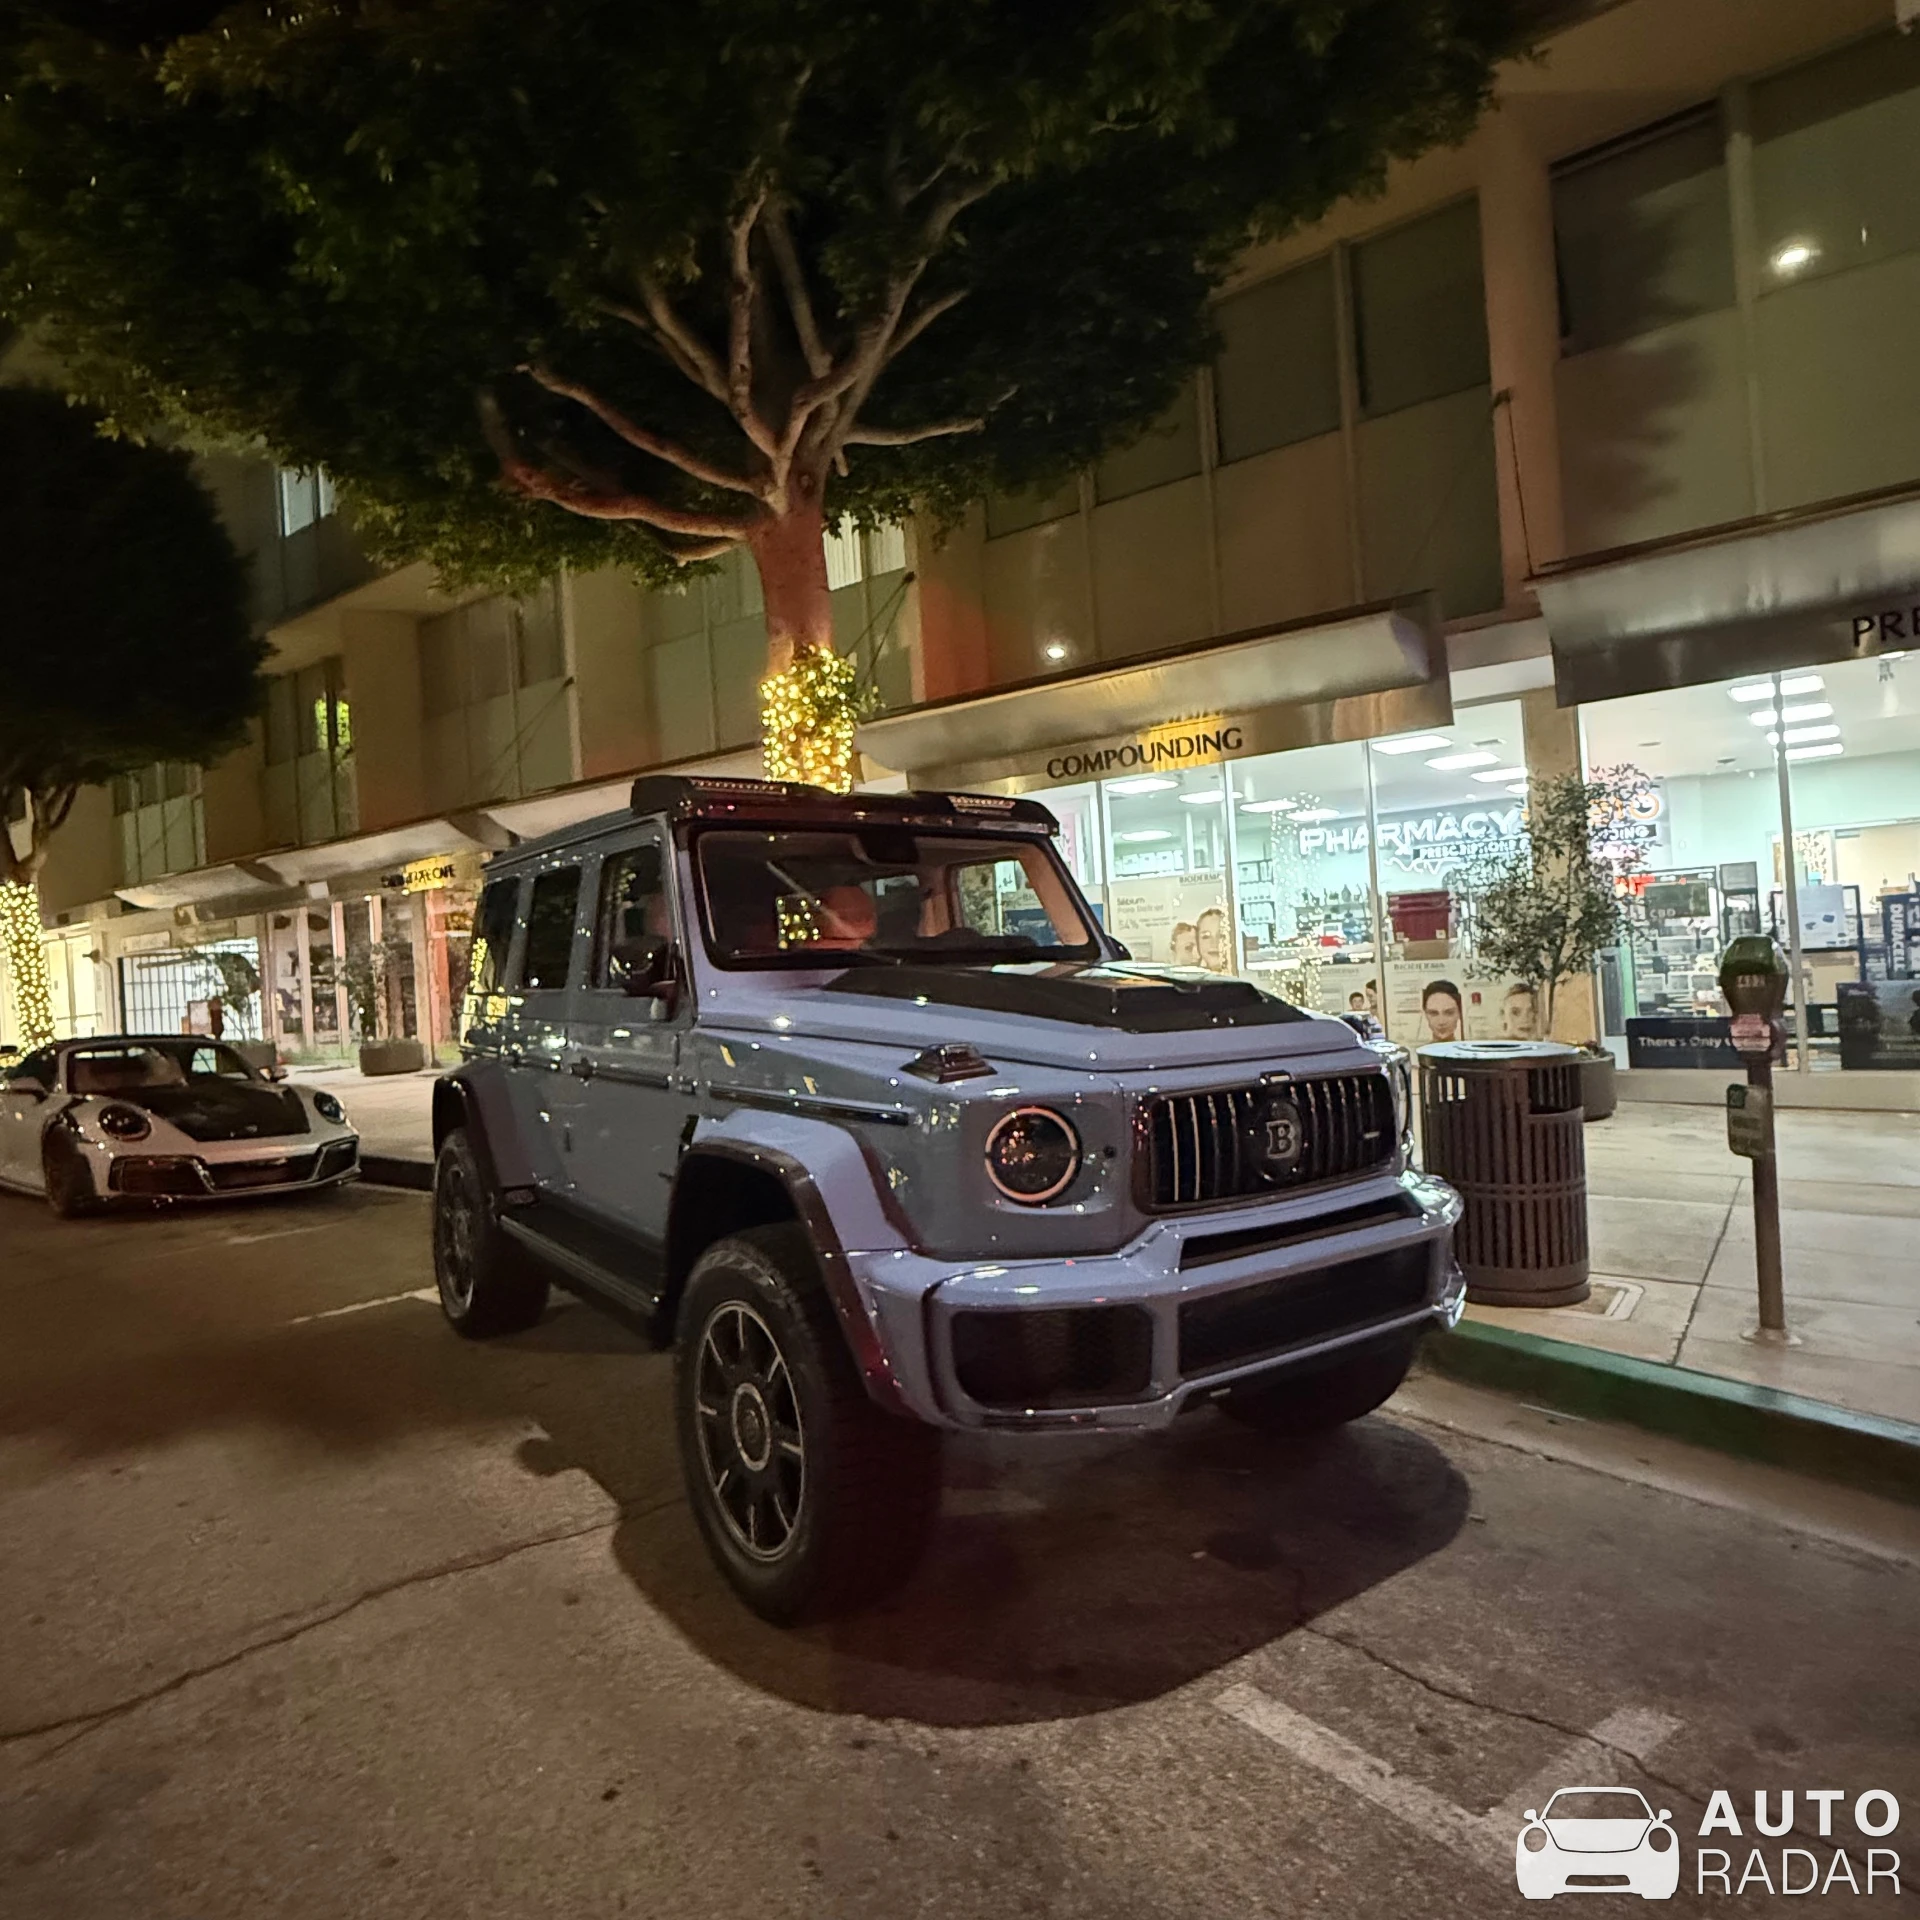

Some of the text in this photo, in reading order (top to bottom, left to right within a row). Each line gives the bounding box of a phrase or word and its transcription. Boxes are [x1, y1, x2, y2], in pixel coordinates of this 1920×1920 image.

[1046, 727, 1243, 779] COMPOUNDING
[1299, 807, 1521, 856] PHARMACY
[1889, 903, 1906, 973] DURACELL
